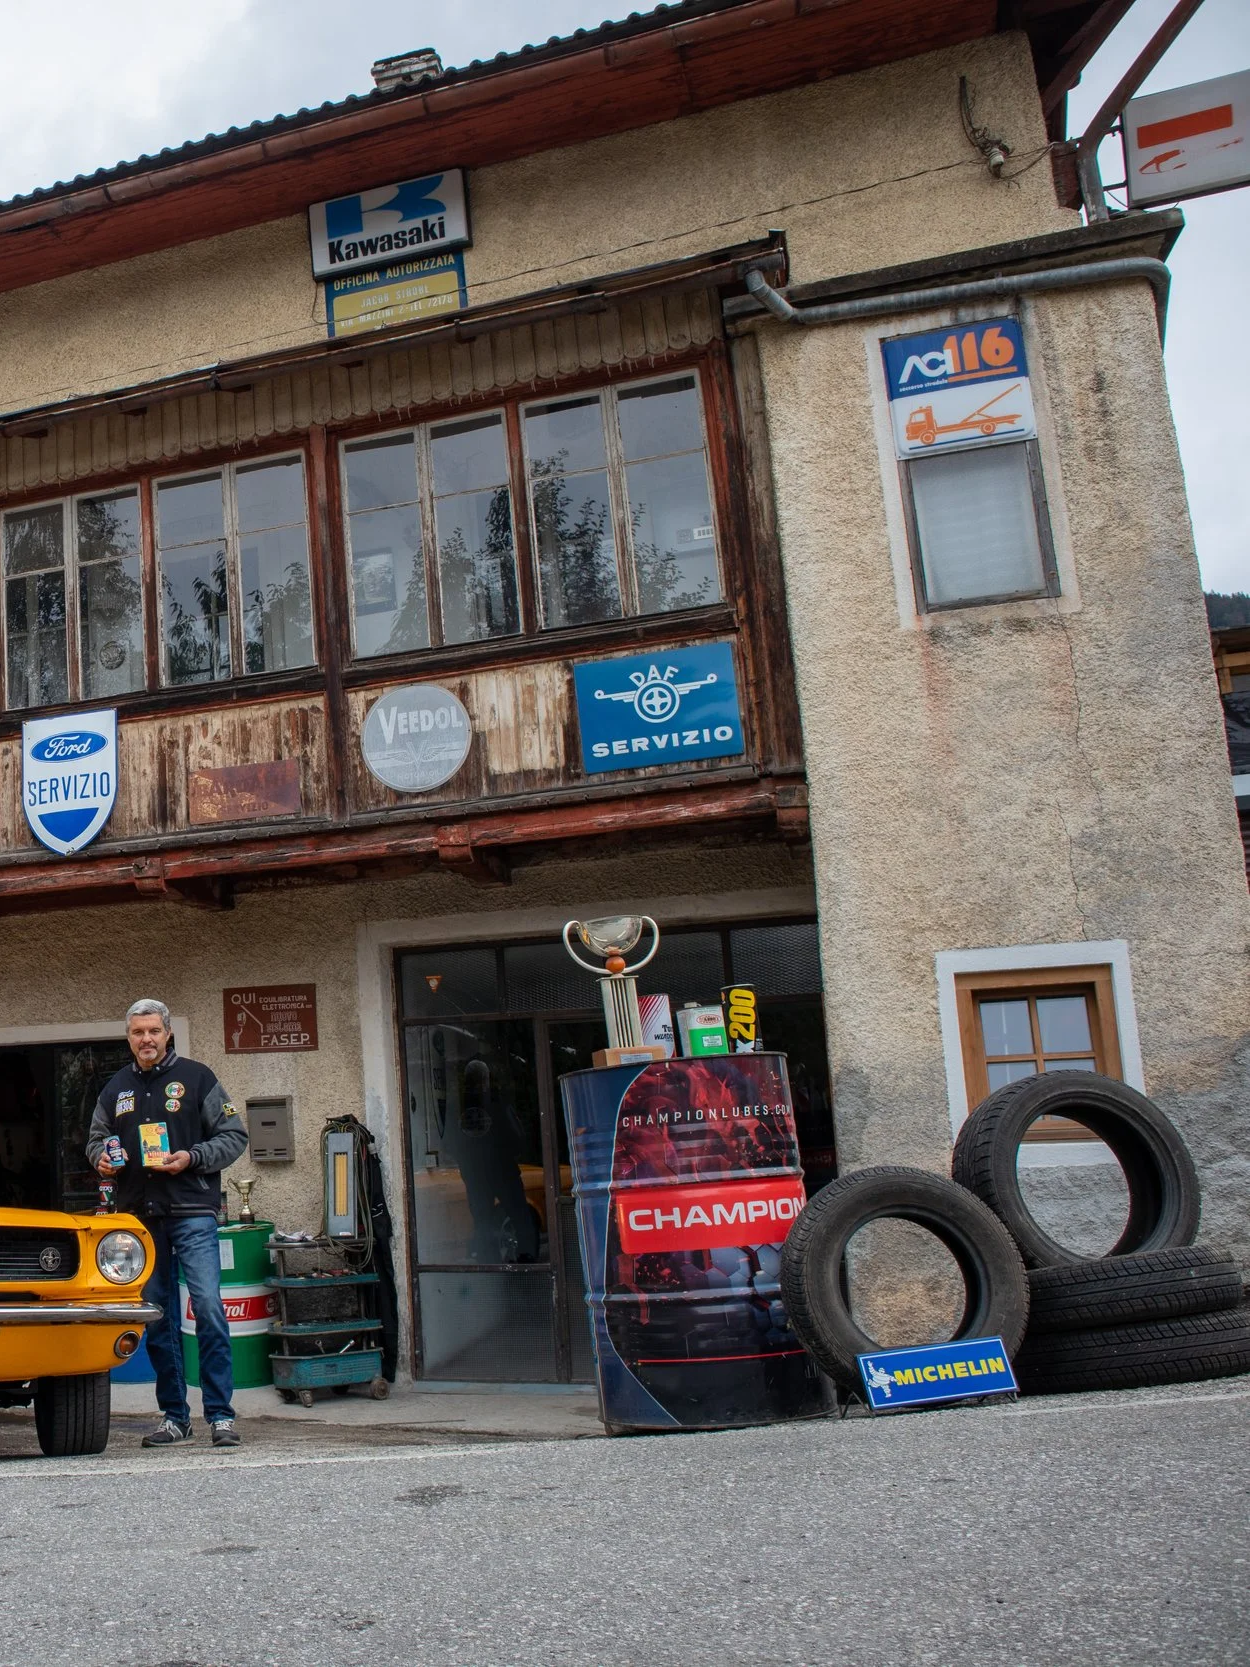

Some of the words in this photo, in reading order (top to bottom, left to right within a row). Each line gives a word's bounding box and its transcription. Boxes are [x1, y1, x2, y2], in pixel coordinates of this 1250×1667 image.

[328, 216, 446, 265] Kawasaki
[333, 271, 380, 291] OFFICINA
[386, 254, 455, 279] AUTORIZZATA
[942, 327, 1015, 373] 116
[628, 665, 679, 688] DAF
[376, 706, 464, 745] VEEDOL
[44, 735, 92, 759] Ford
[591, 726, 733, 758] SERVIZIO
[28, 772, 110, 807] SERVIZIO
[231, 992, 256, 1005] QUI
[259, 995, 308, 1004] EQUILIBRATURA
[262, 1003, 304, 1011] ELETTRONICA
[622, 1104, 791, 1128] CHAMPIONLUBES.COM
[628, 1197, 805, 1231] CHAMPION
[893, 1357, 1006, 1386] MICHELIN
